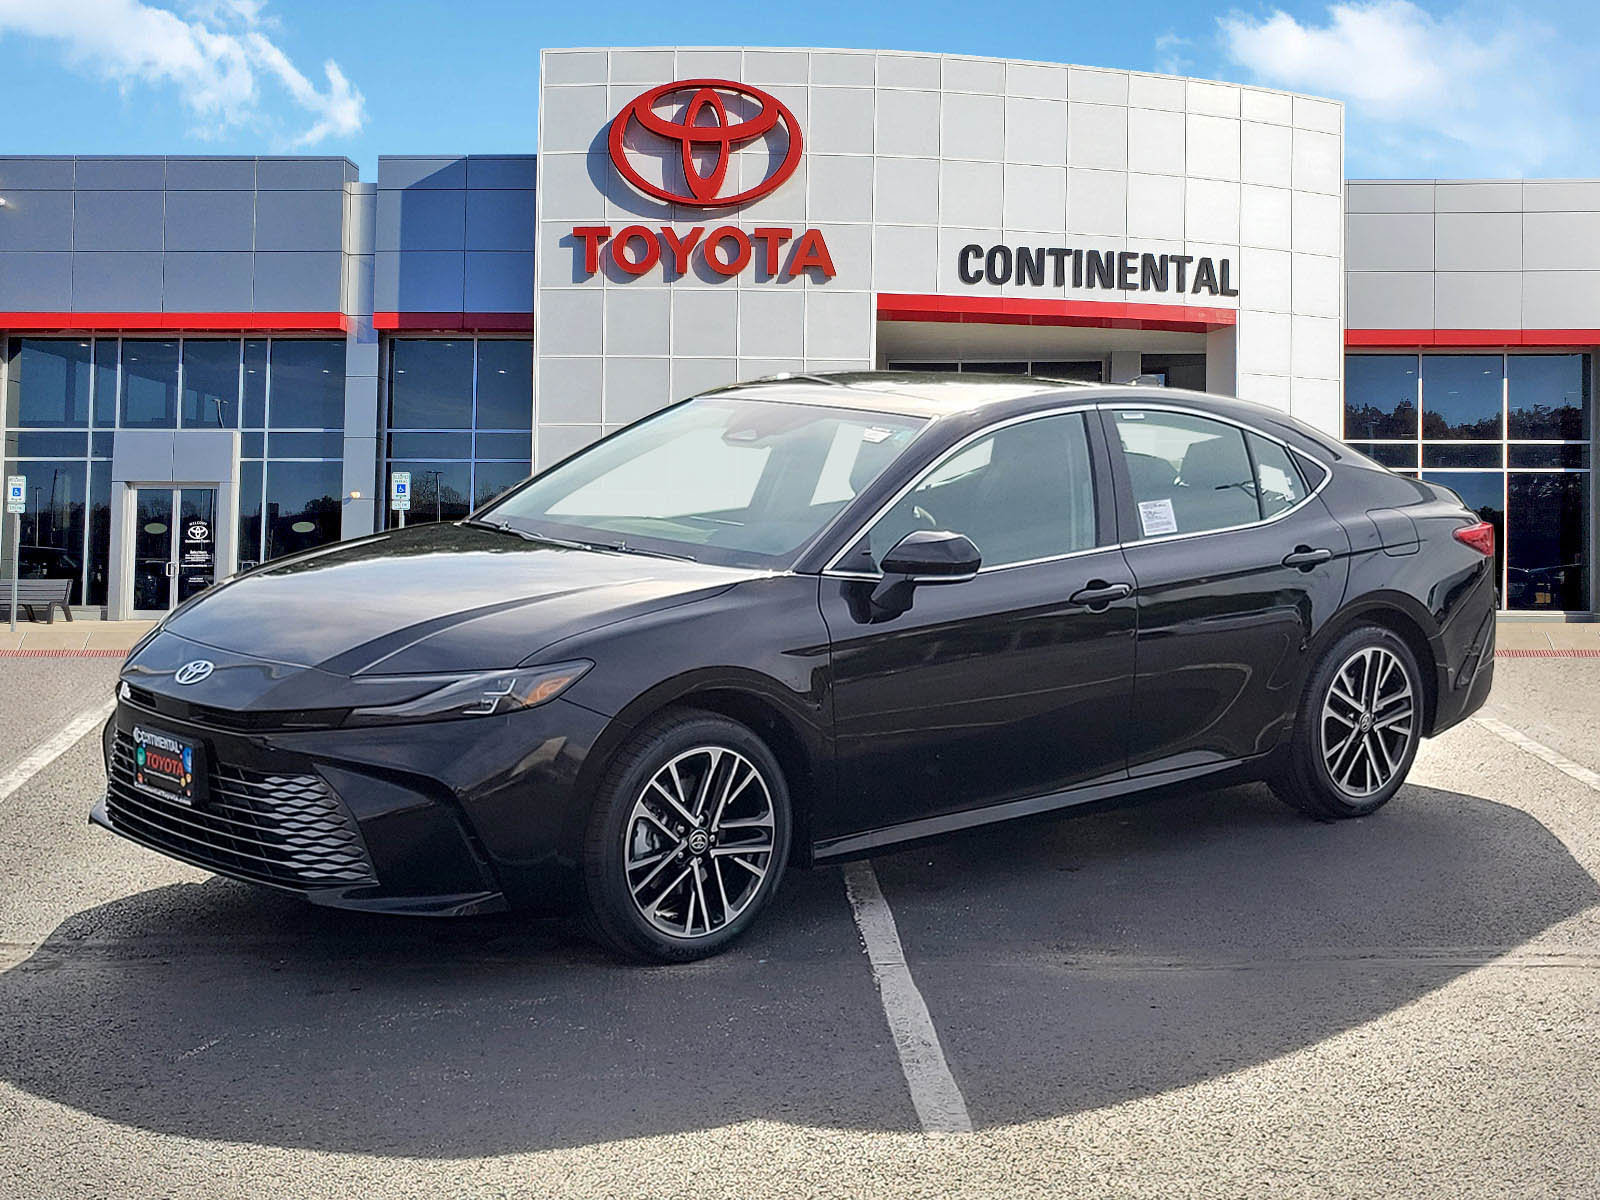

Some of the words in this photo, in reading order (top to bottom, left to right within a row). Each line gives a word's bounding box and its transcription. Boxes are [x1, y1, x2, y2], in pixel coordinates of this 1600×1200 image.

[572, 225, 837, 277] TOYOTA
[958, 244, 1239, 297] CONTINENTAL
[146, 751, 185, 777] TOYOTA
